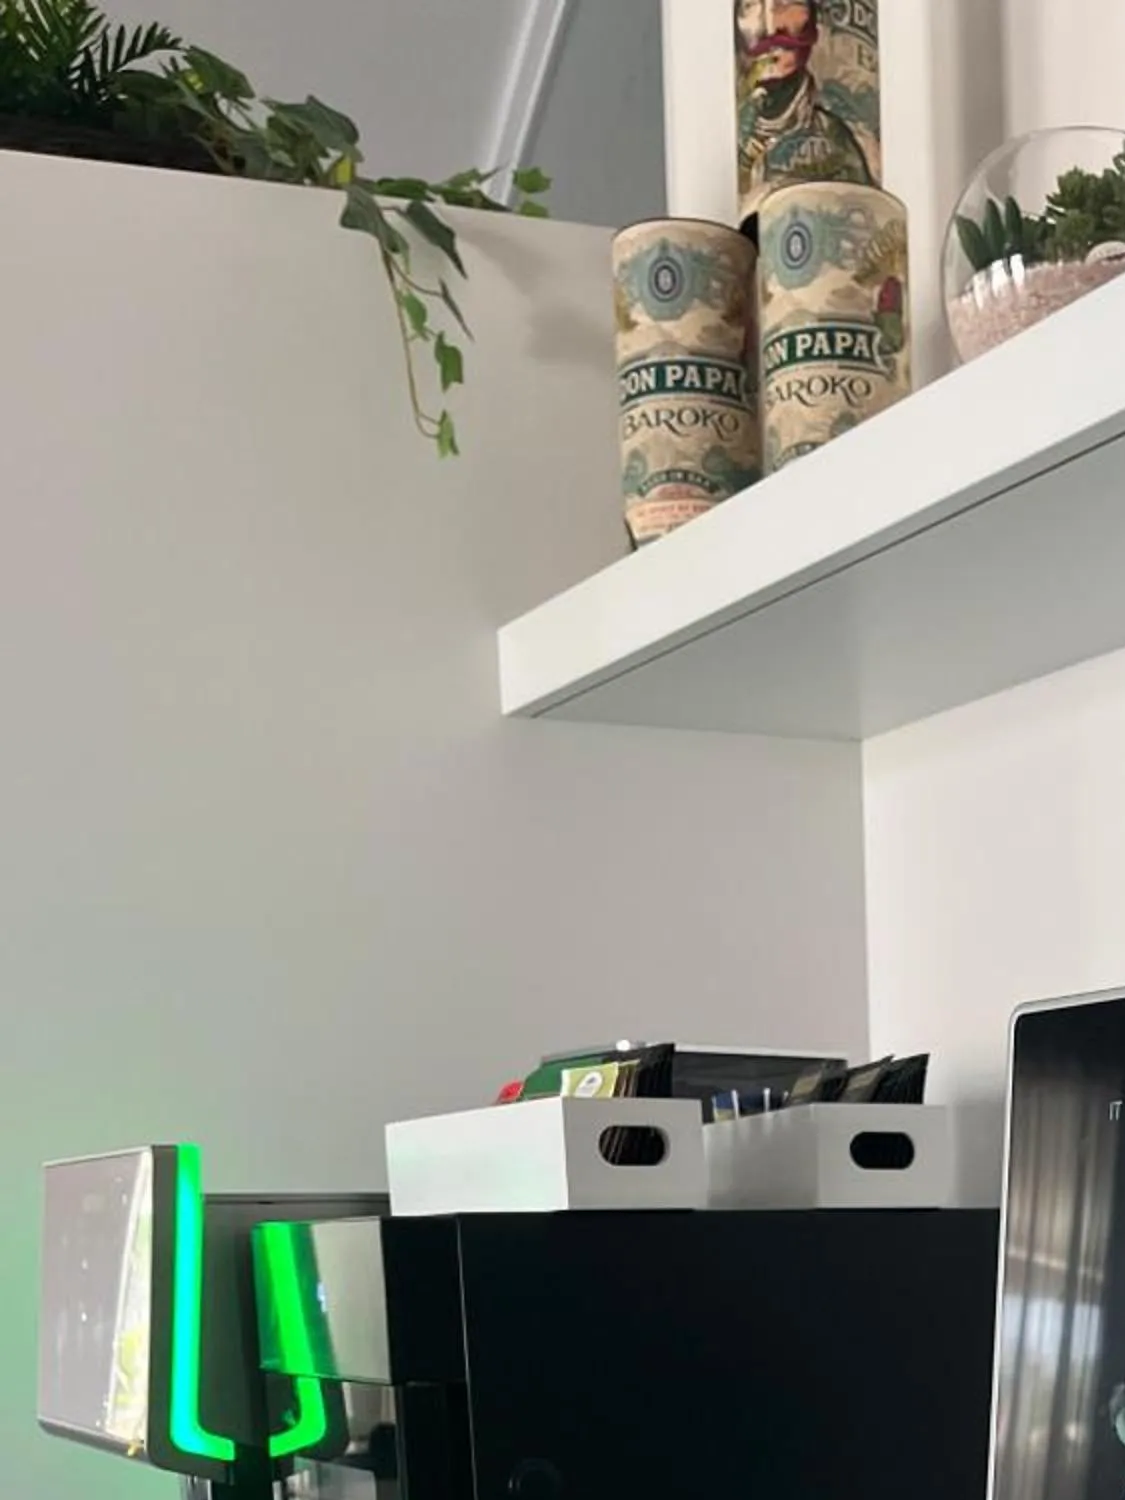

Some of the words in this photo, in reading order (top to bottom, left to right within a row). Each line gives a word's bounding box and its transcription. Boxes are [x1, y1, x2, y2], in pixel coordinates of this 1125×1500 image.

[795, 331, 871, 359] PAPA
[665, 365, 739, 396] PAPA
[766, 374, 872, 408] AROKO
[623, 406, 740, 441] BAROKO
